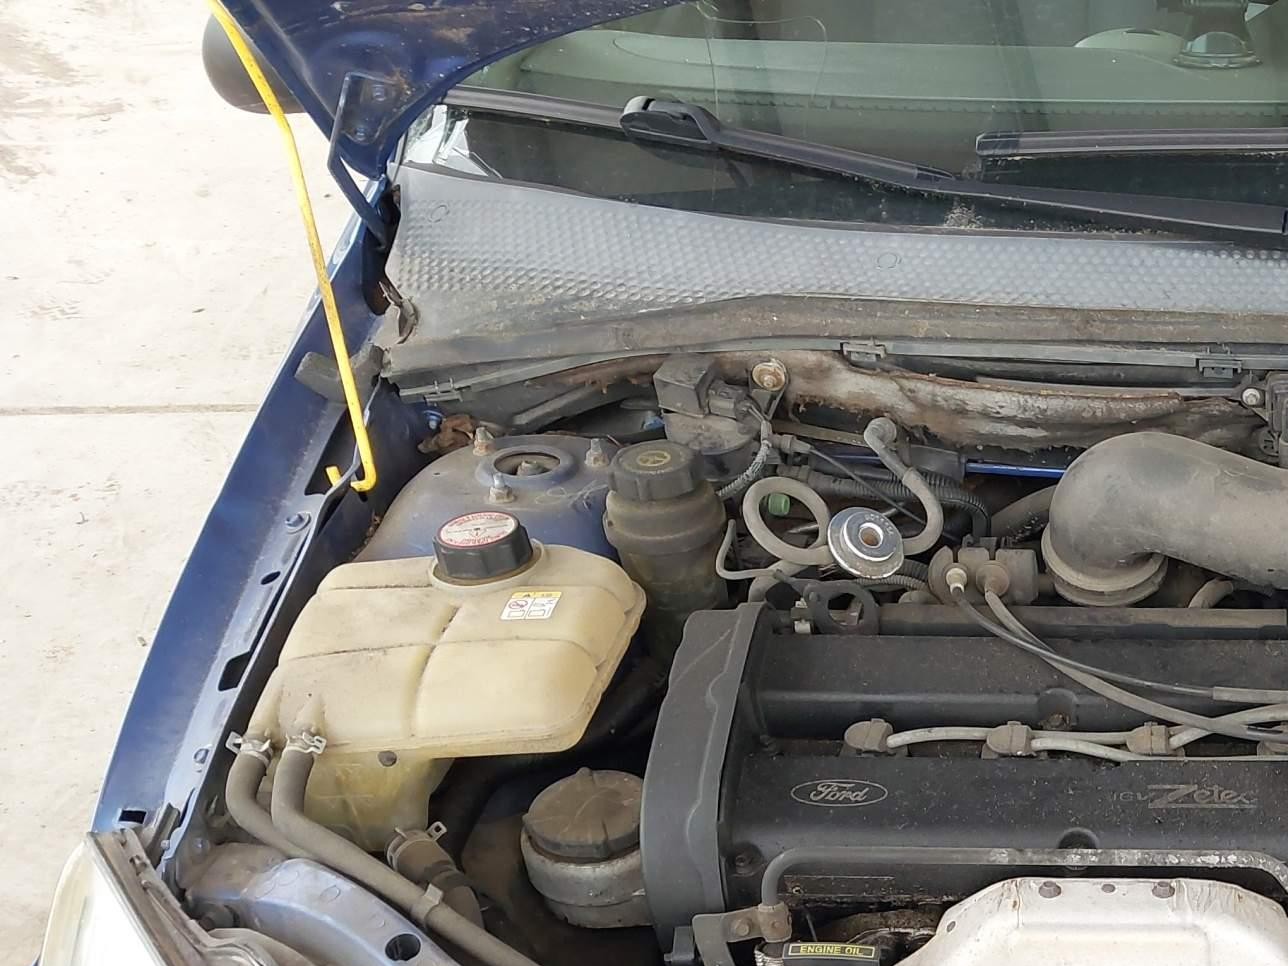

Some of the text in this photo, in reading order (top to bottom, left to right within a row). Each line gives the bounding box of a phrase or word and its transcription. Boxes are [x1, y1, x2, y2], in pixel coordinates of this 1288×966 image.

[809, 782, 870, 802] Ford
[800, 944, 864, 956] ENGINE OIL
